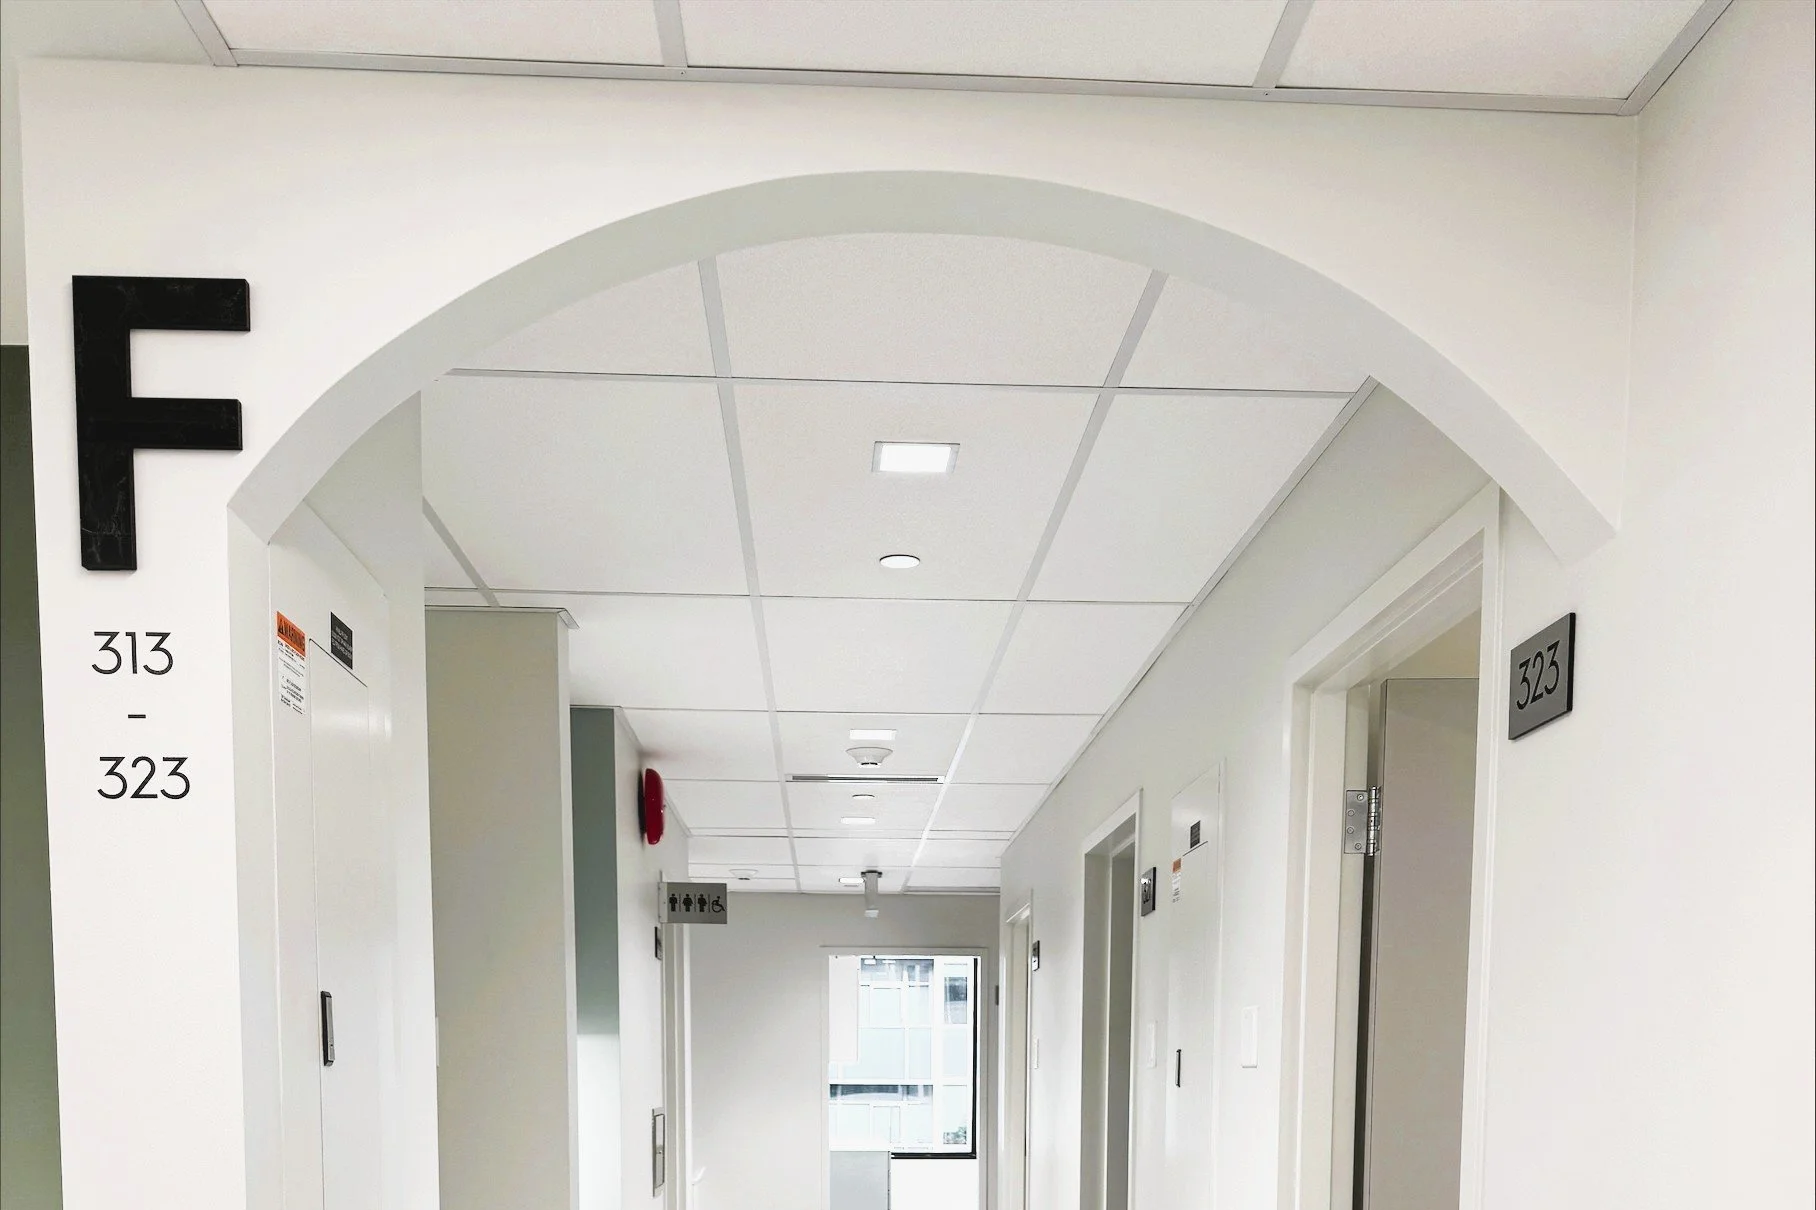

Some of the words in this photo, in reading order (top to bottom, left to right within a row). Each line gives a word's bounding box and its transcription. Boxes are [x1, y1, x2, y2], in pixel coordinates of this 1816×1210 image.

[72, 275, 250, 571] F
[92, 632, 174, 676] 313
[1516, 639, 1560, 710] 323
[97, 756, 191, 800] 323
